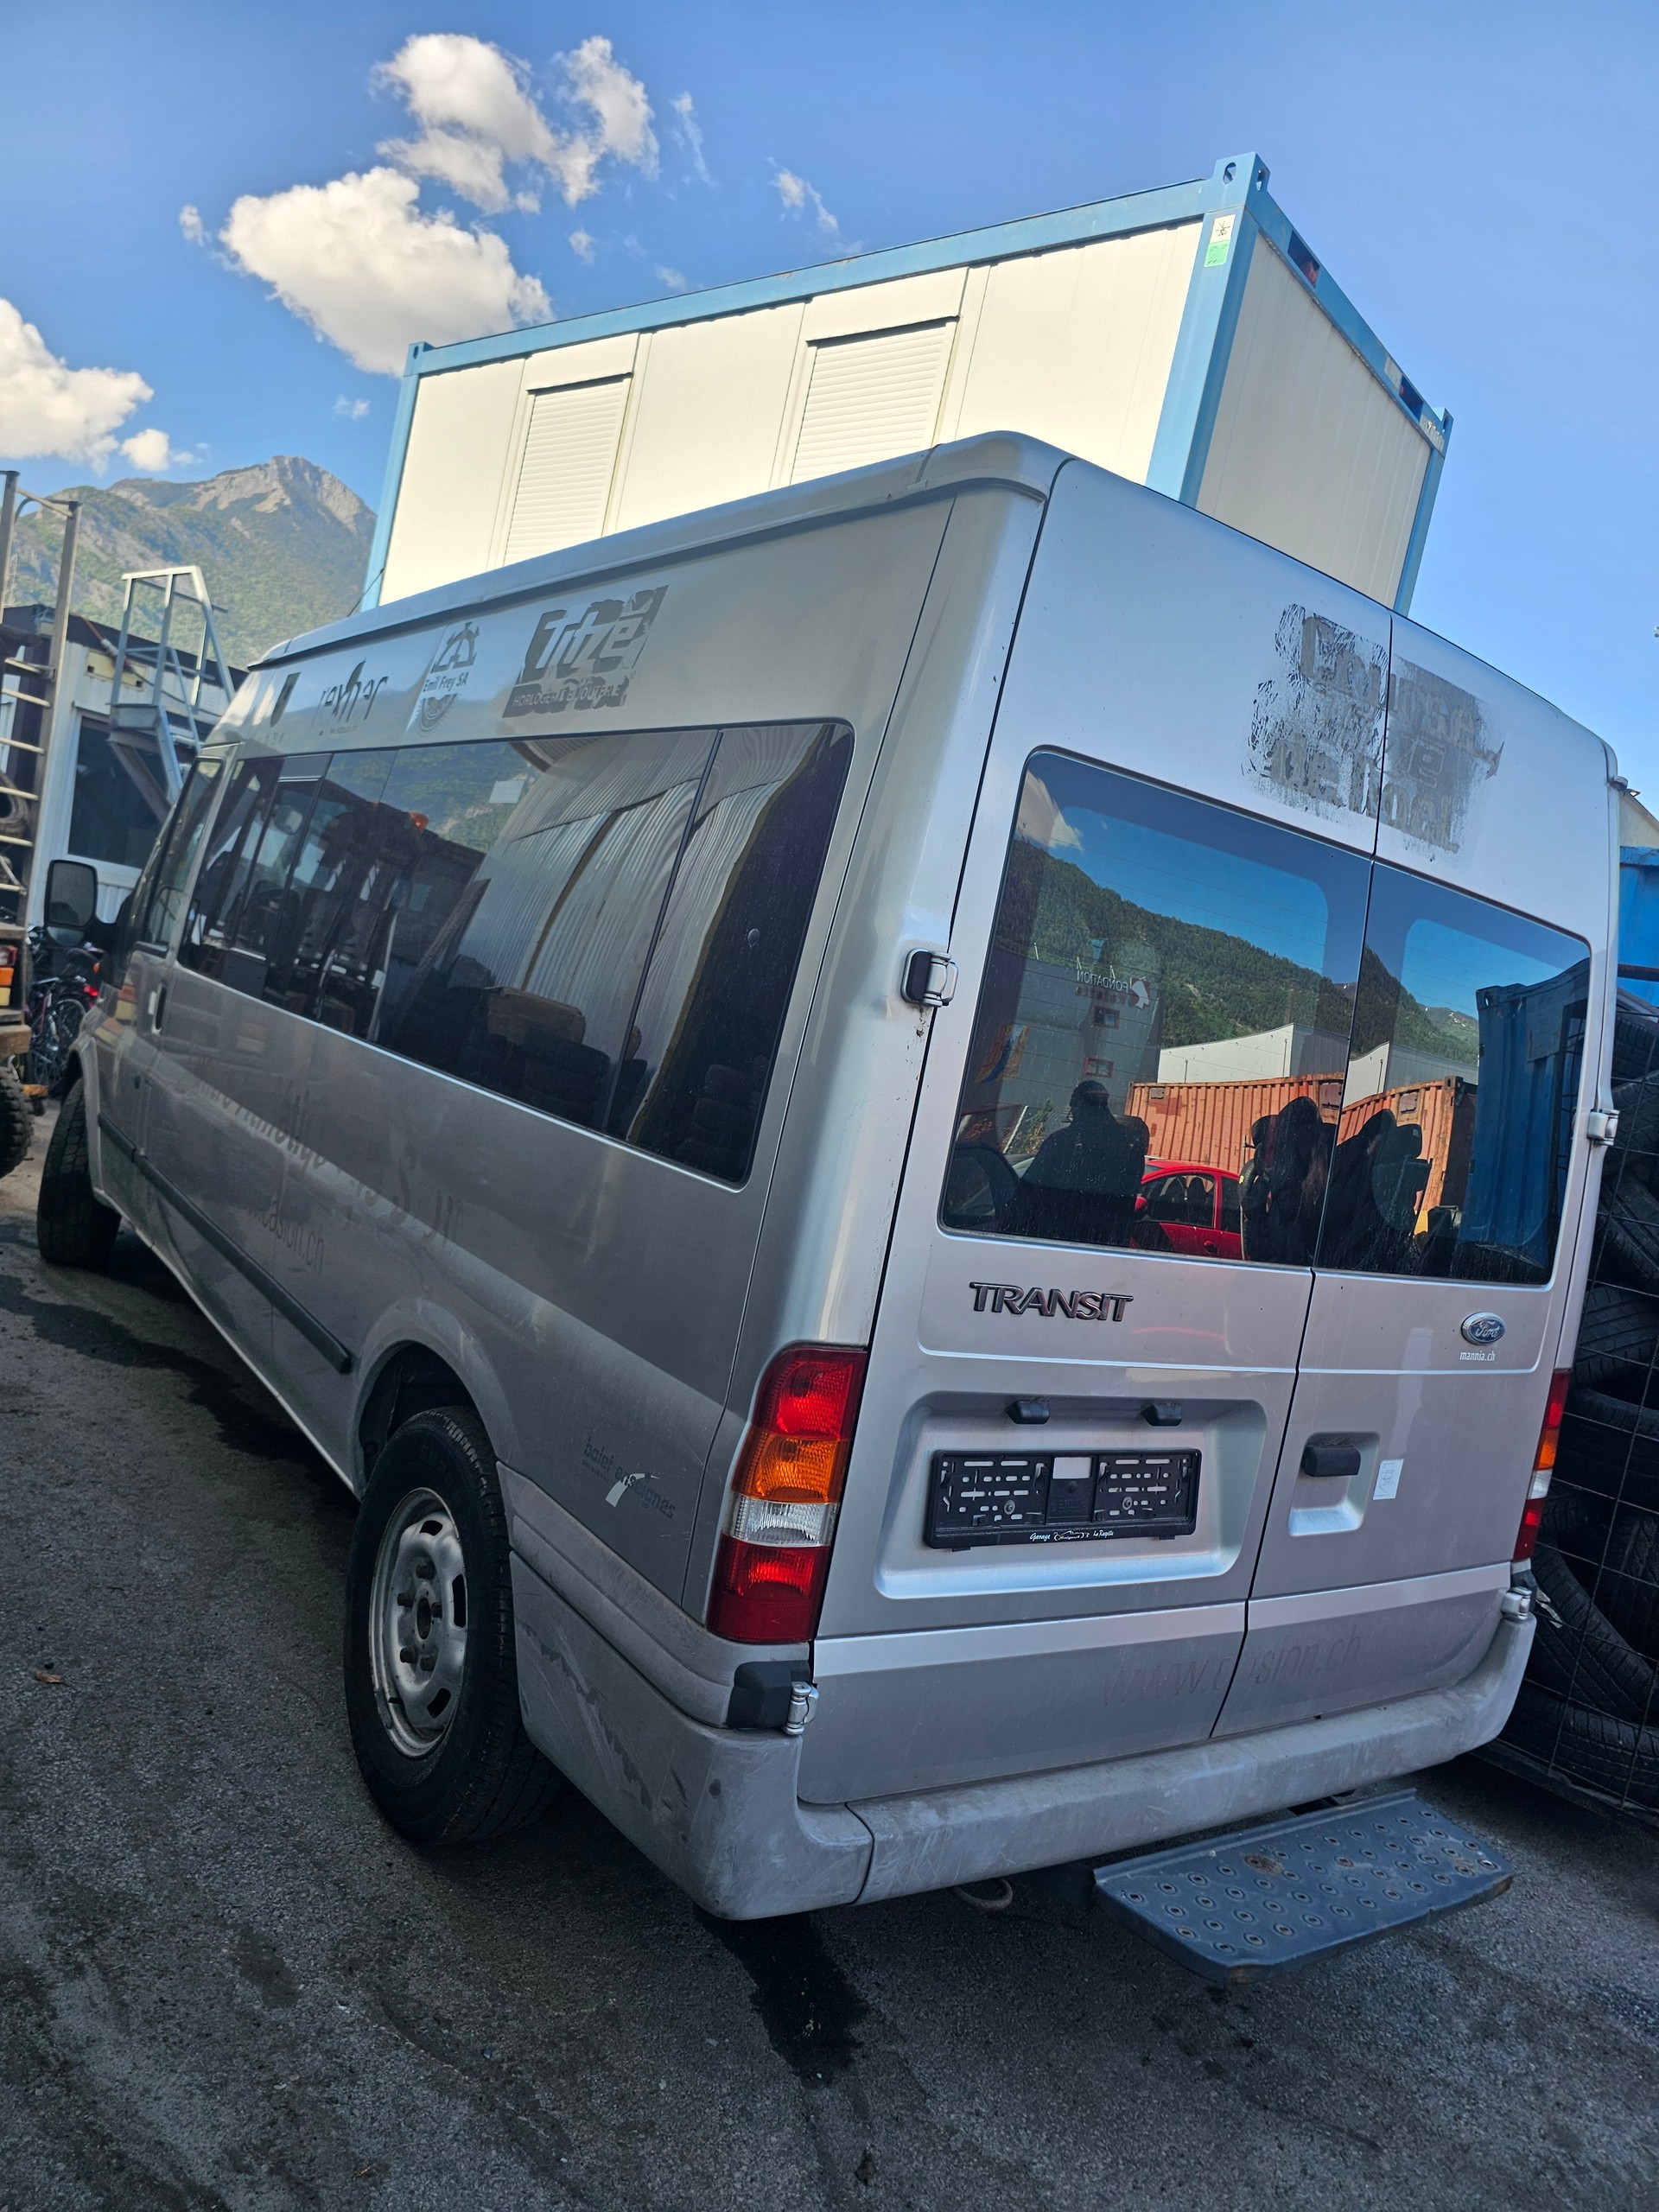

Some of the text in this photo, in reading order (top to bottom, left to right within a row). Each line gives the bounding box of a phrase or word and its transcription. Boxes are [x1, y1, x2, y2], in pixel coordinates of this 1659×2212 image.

[423, 672, 469, 693] Emil Frey SA
[969, 1281, 1135, 1322] TRANSIT
[1475, 1321, 1500, 1338] Ford
[1459, 1351, 1496, 1362] mannia.ch
[1103, 1625, 1361, 1707] www.csion.ch
